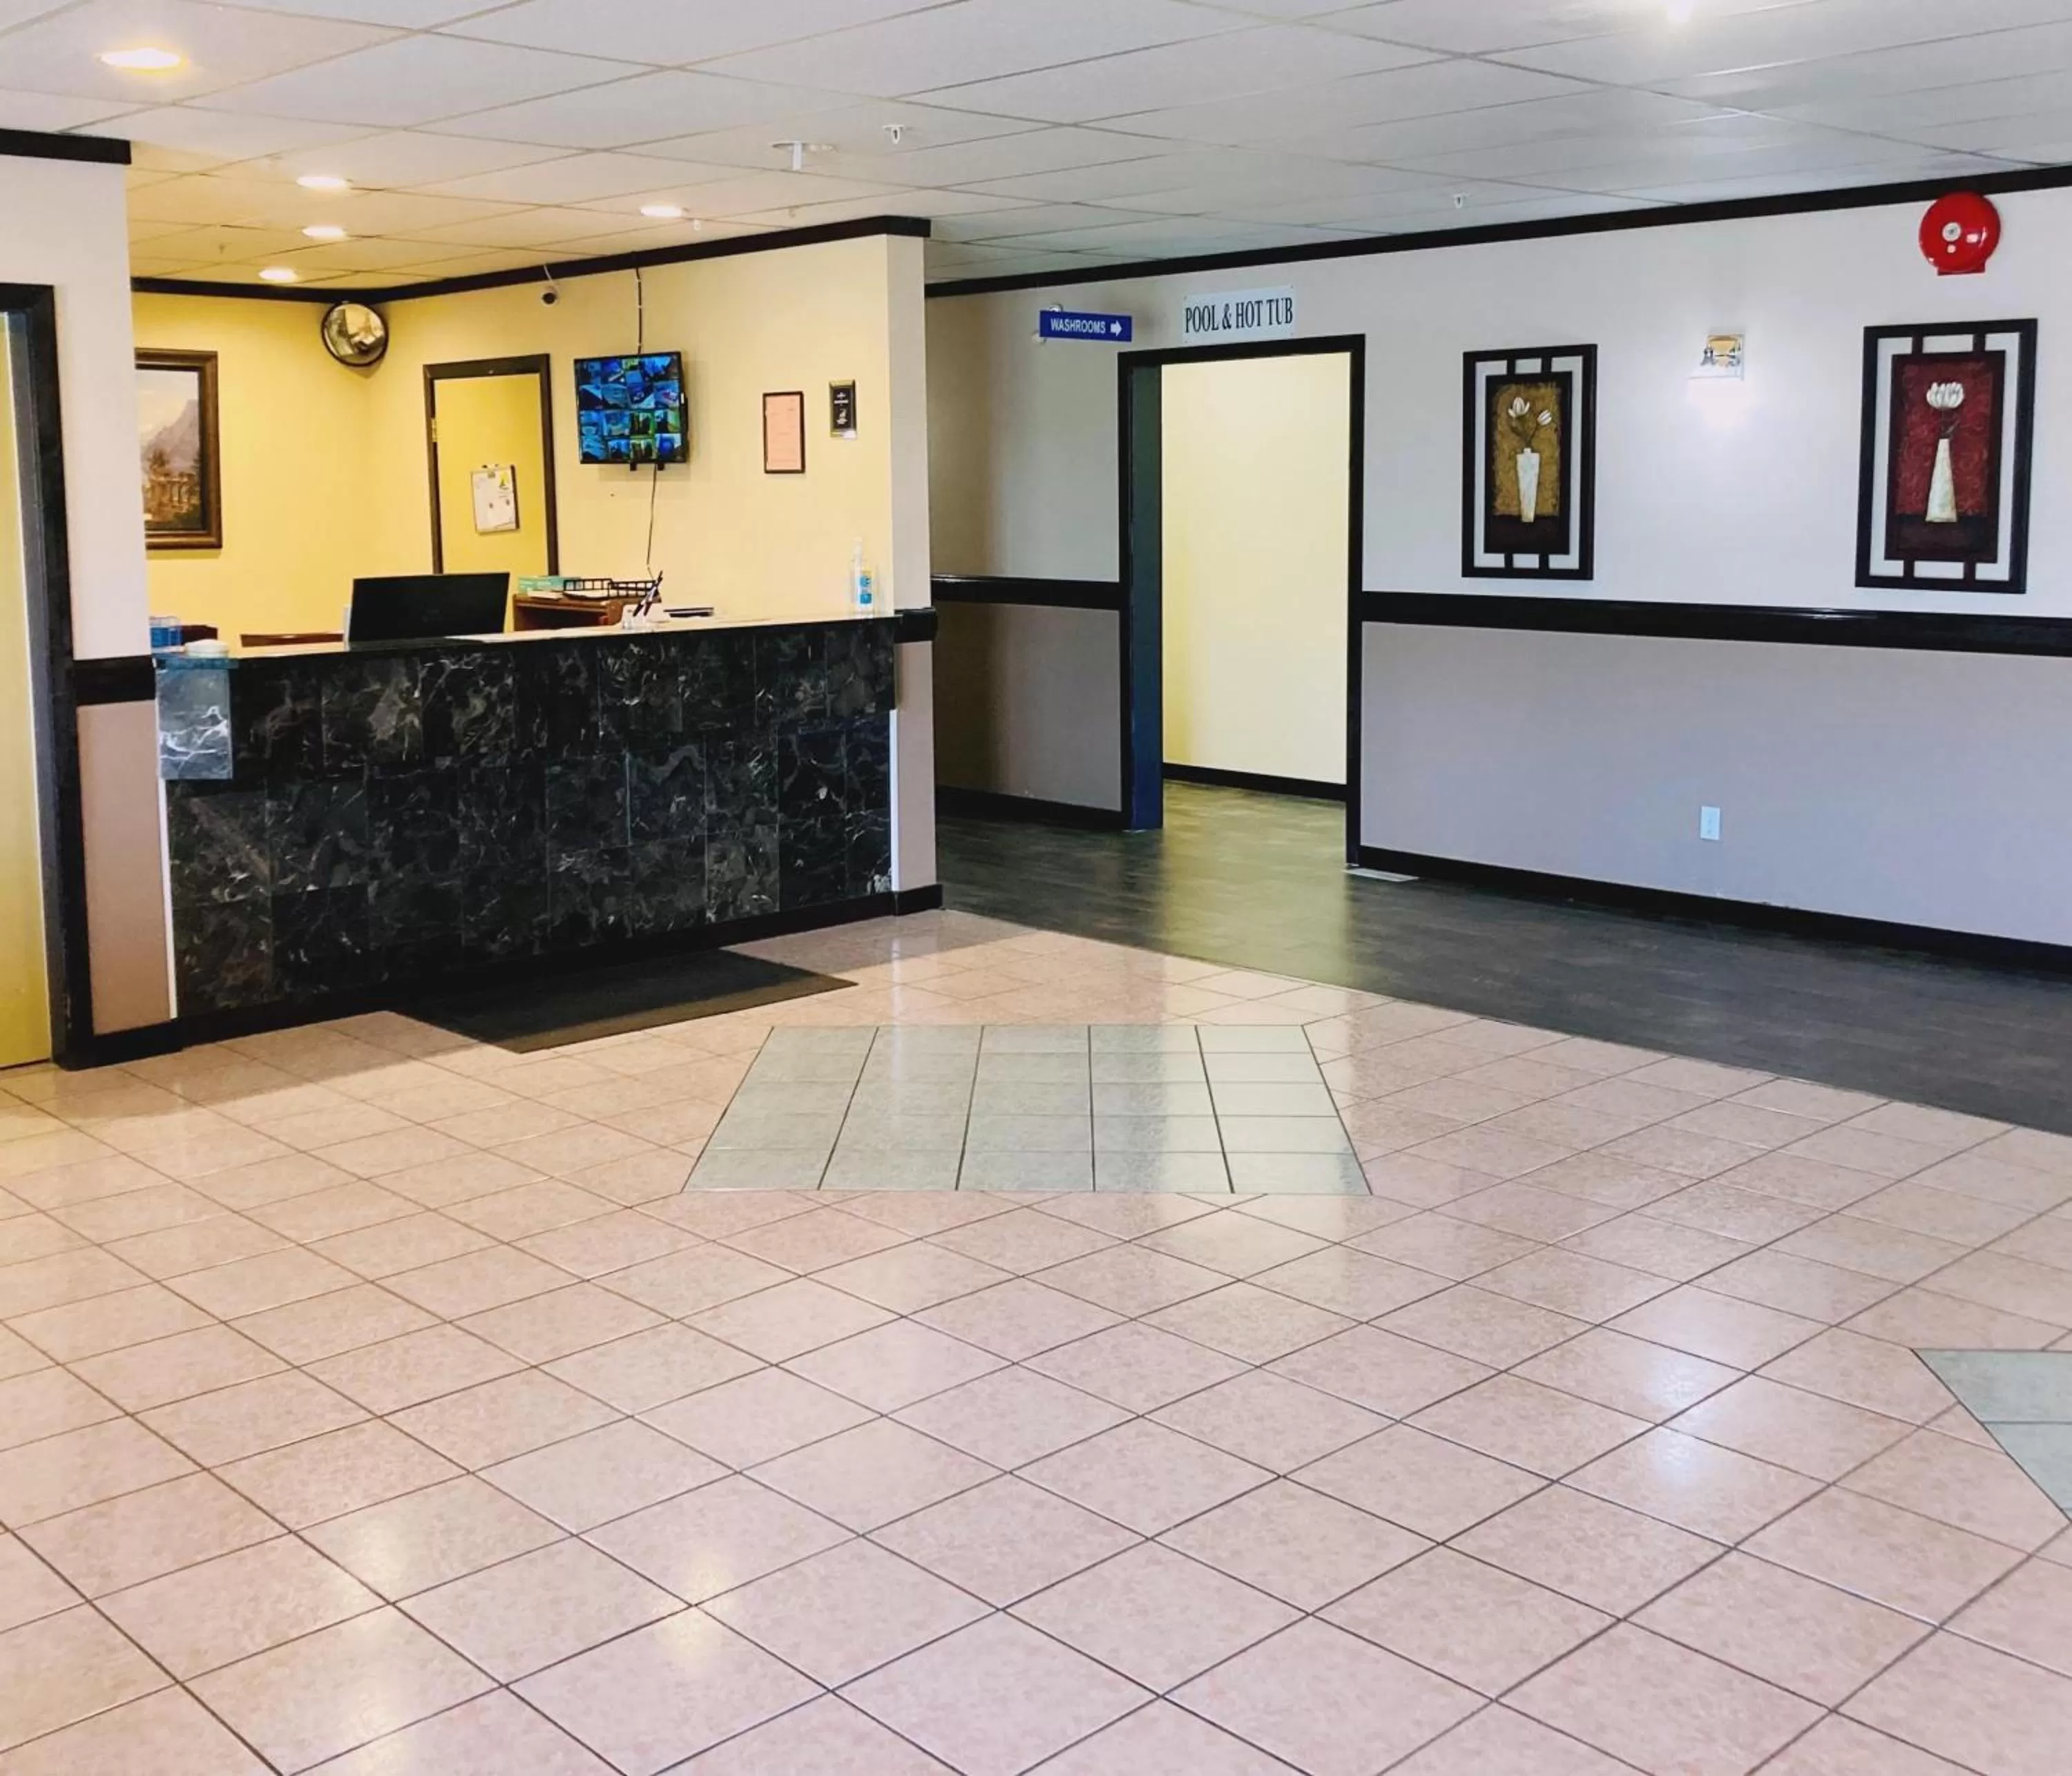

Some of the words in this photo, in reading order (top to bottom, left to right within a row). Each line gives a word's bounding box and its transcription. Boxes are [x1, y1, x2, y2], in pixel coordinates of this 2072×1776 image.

[1051, 318, 1106, 334] WASHROOMS
[1185, 305, 1219, 333] POOL
[1222, 303, 1232, 329] &
[1236, 300, 1263, 328] HOT
[1266, 298, 1293, 326] TUB
